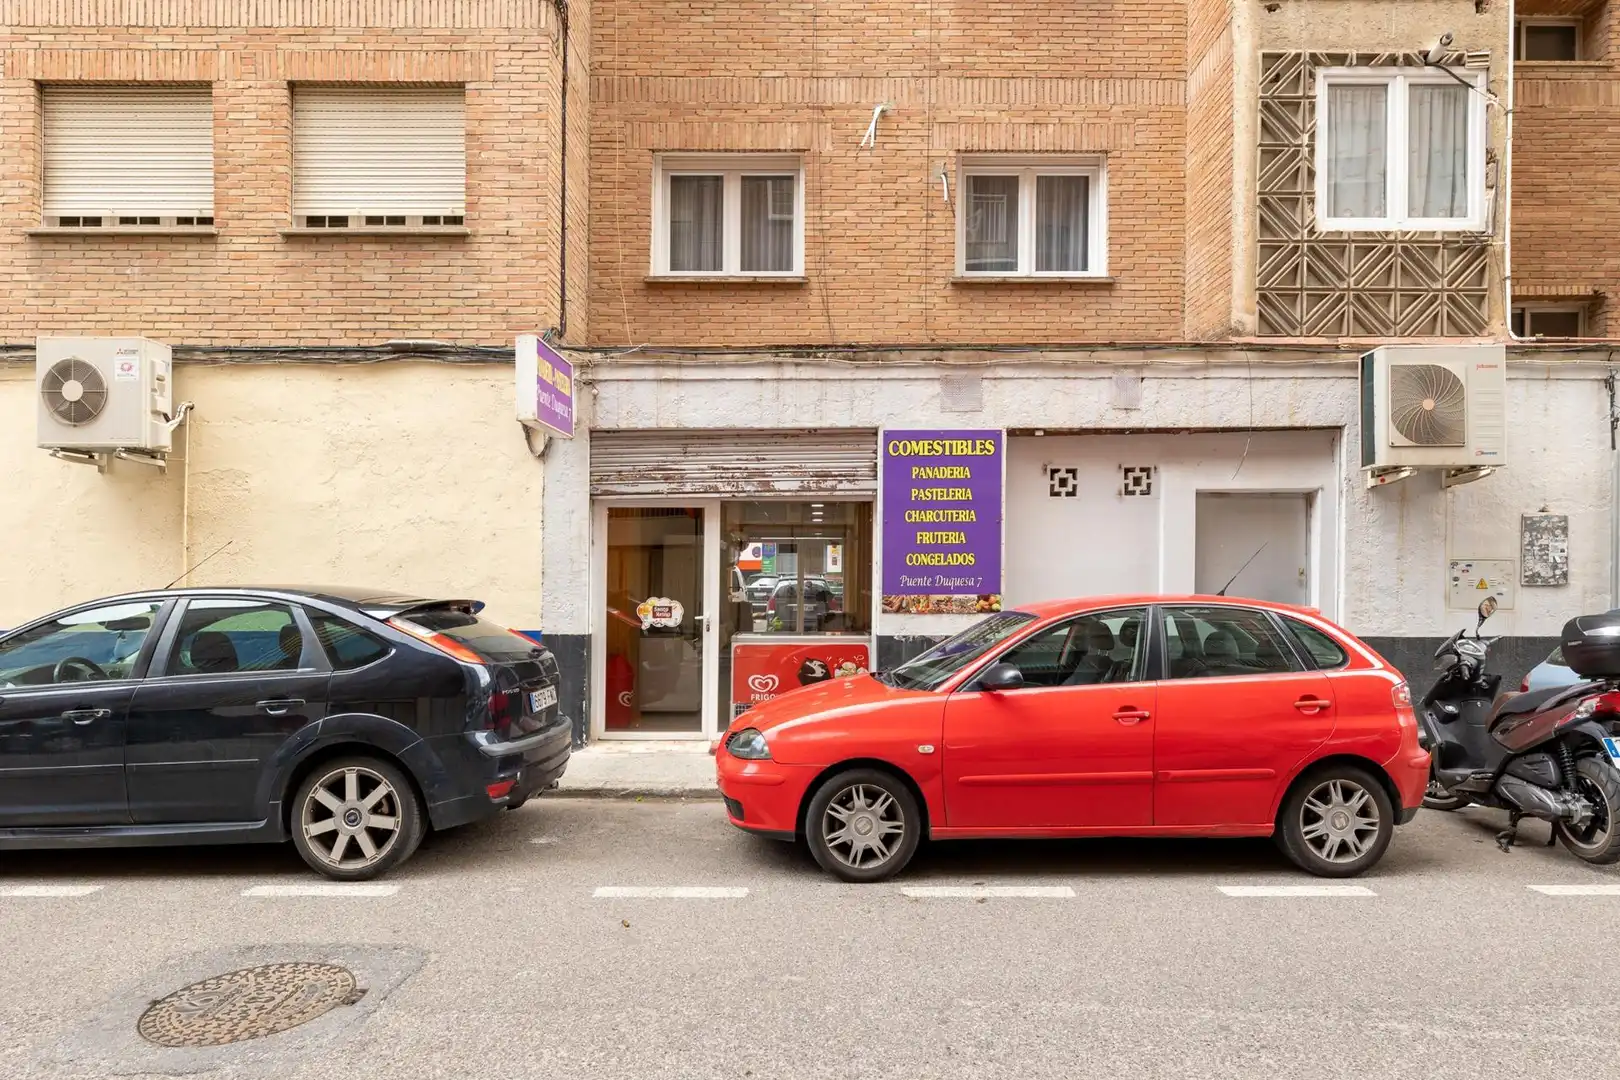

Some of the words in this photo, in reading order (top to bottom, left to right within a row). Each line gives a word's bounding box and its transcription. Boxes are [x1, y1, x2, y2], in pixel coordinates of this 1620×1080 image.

[888, 440, 995, 456] COMESTIBLES
[912, 466, 971, 479] PANADERIA
[911, 488, 973, 501] PASTELERIA
[905, 510, 976, 522] CHARCUTERIA
[916, 531, 966, 544] FRUTERIA
[906, 553, 975, 566] CONGELADOS
[900, 574, 933, 587] Puente
[934, 574, 975, 589] Duquesa
[977, 577, 983, 587] 7
[751, 693, 776, 701] FRIGO
